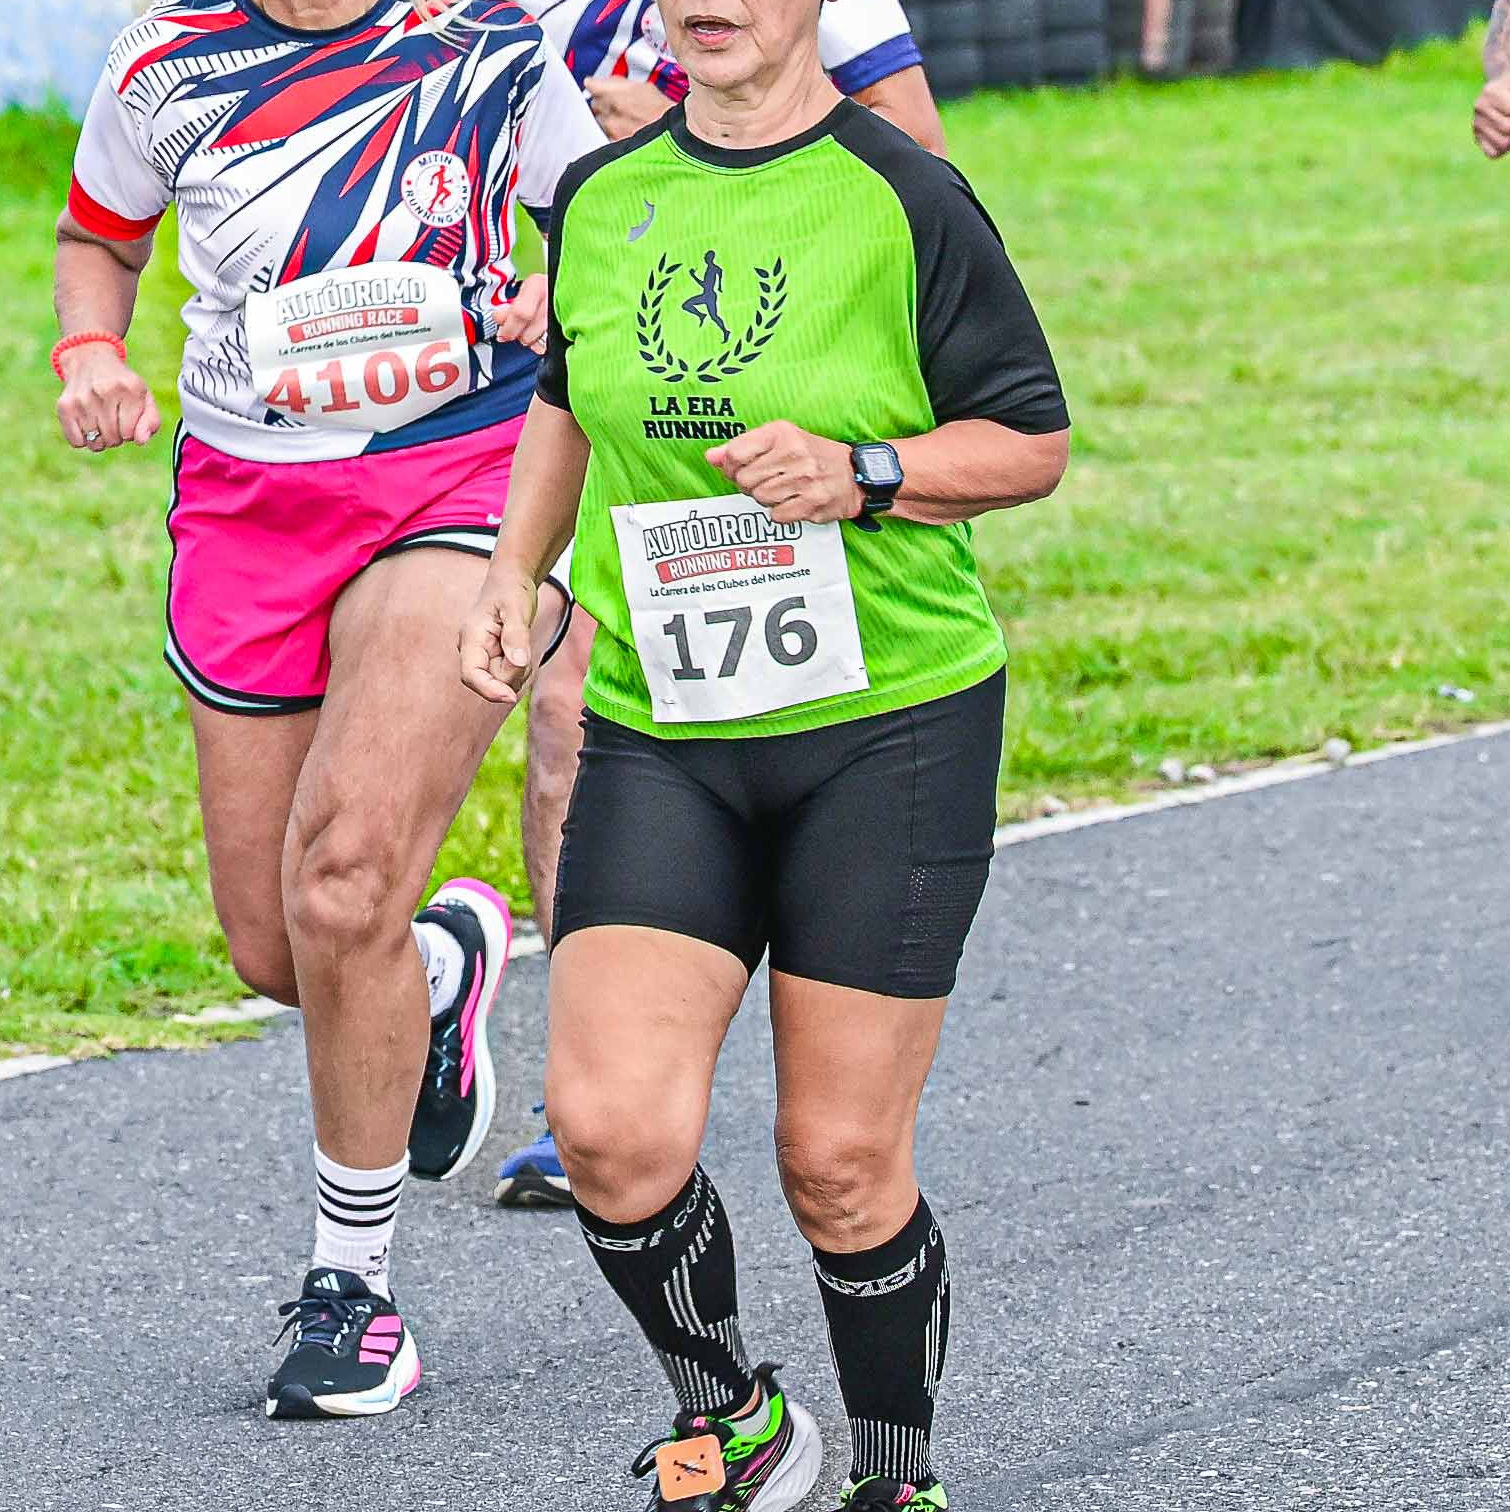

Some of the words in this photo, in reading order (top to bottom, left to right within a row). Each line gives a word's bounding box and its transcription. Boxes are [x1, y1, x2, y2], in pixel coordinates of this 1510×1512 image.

[276, 277, 426, 325] AUTÓDROMO
[301, 311, 363, 339] RUNNING
[367, 308, 404, 326] RACE
[279, 346, 289, 356] La
[290, 342, 322, 354] Carrera
[323, 340, 335, 349] de
[335, 338, 348, 347] los
[350, 333, 380, 346] Clubes
[380, 331, 394, 341] del
[264, 341, 461, 414] 4106
[649, 396, 682, 416] LA
[687, 396, 735, 417] ERA
[642, 510, 803, 560] AUTÓDROMO
[667, 552, 732, 580] RUNNING
[735, 548, 778, 567] RACE
[649, 587, 660, 597] La
[660, 586, 689, 596] Carrera
[689, 584, 701, 593] de
[702, 582, 716, 592] los
[717, 578, 750, 590] Clubes
[751, 574, 766, 585] del
[768, 568, 811, 582] Noroeste
[662, 595, 818, 681] 176
